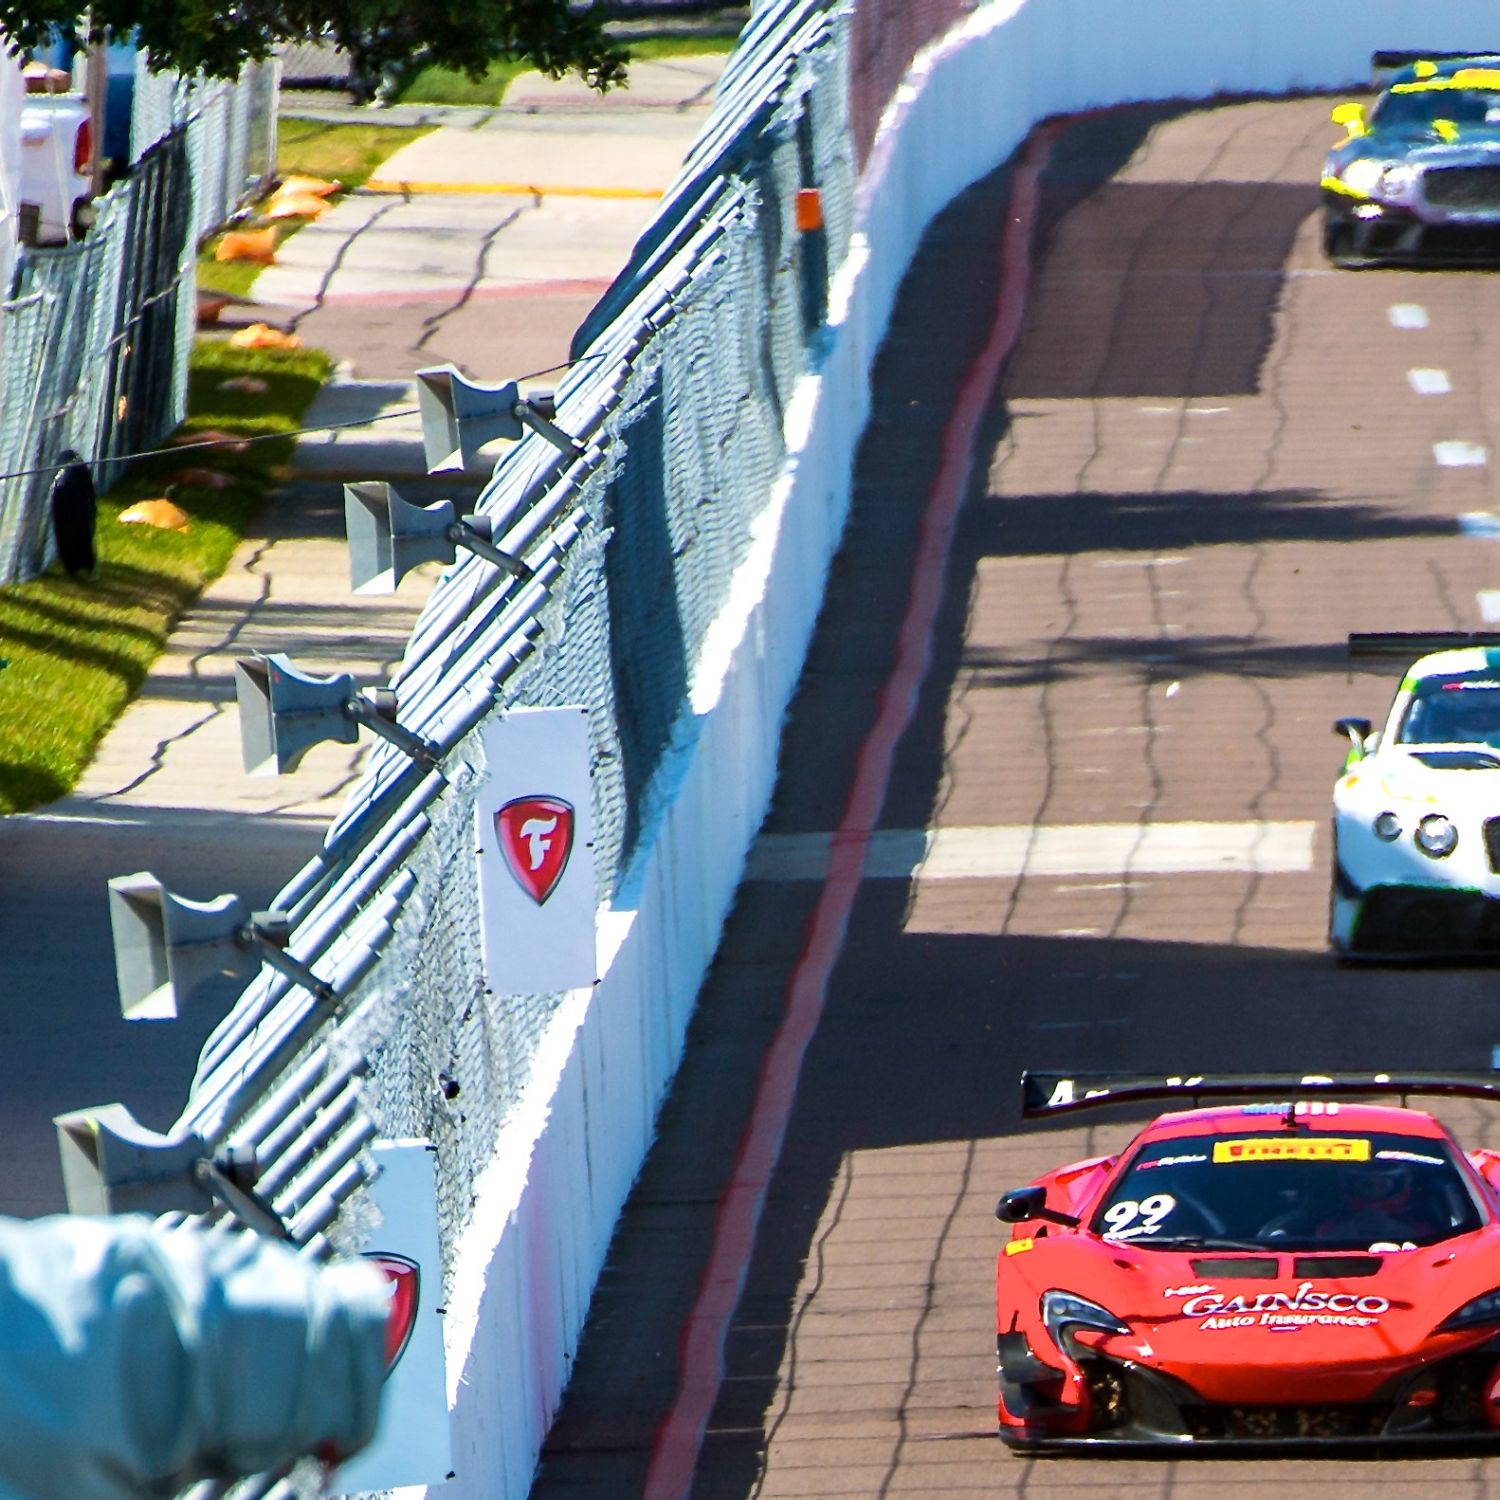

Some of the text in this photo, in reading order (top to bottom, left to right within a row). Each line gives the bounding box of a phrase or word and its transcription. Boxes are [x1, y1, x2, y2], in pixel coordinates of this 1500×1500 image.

[1104, 1194, 1176, 1233] 99
[1182, 1282, 1390, 1317] GAINSCO
[1200, 1312, 1373, 1330] Auto Insurance
